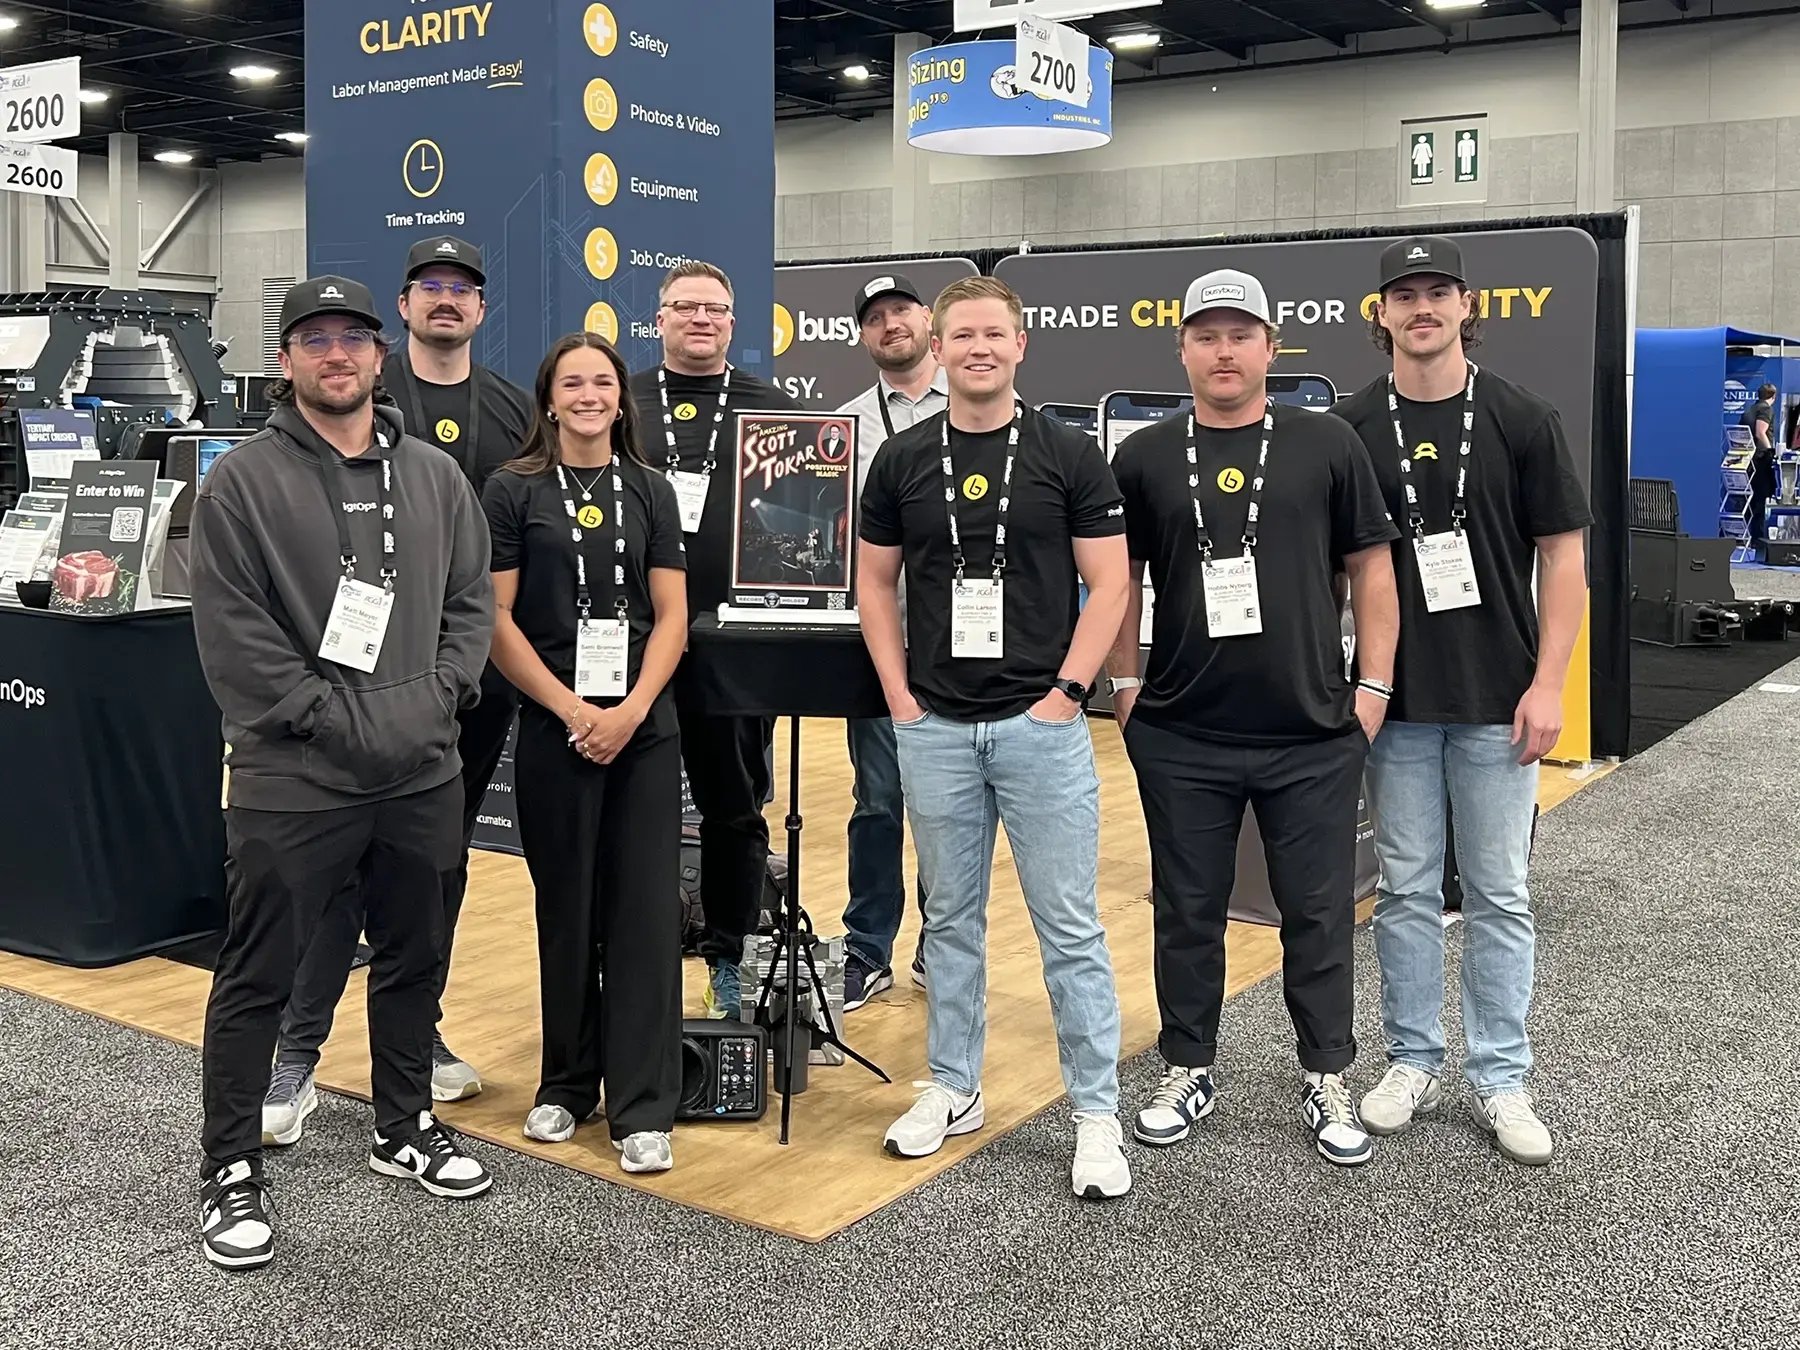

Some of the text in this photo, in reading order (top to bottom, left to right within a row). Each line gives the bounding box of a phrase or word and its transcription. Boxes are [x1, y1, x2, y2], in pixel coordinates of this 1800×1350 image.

[360, 2, 493, 54] CLARITY
[630, 30, 669, 58] Safety
[332, 60, 523, 99] Labor Management Made Easy!
[911, 57, 965, 87] Sizing
[1031, 51, 1075, 93] 2700
[7, 93, 64, 133] 2600
[630, 103, 720, 136] Photos & Video
[7, 163, 63, 189] 2600
[630, 176, 699, 203] Equipment
[386, 209, 465, 227] Time Tracking
[630, 249, 653, 267] Job
[1204, 286, 1242, 297] busybusy
[1022, 305, 1118, 329] TRADE
[1277, 299, 1345, 325] FOR
[743, 429, 797, 479] SCOTT
[759, 445, 817, 491] TOKAR
[805, 463, 849, 472] POSITIVELY
[75, 484, 146, 498] Enter to Win
[1463, 581, 1472, 592] E
[1246, 607, 1254, 618] E
[365, 643, 374, 655] E
[989, 631, 997, 642] E
[614, 671, 621, 681] E
